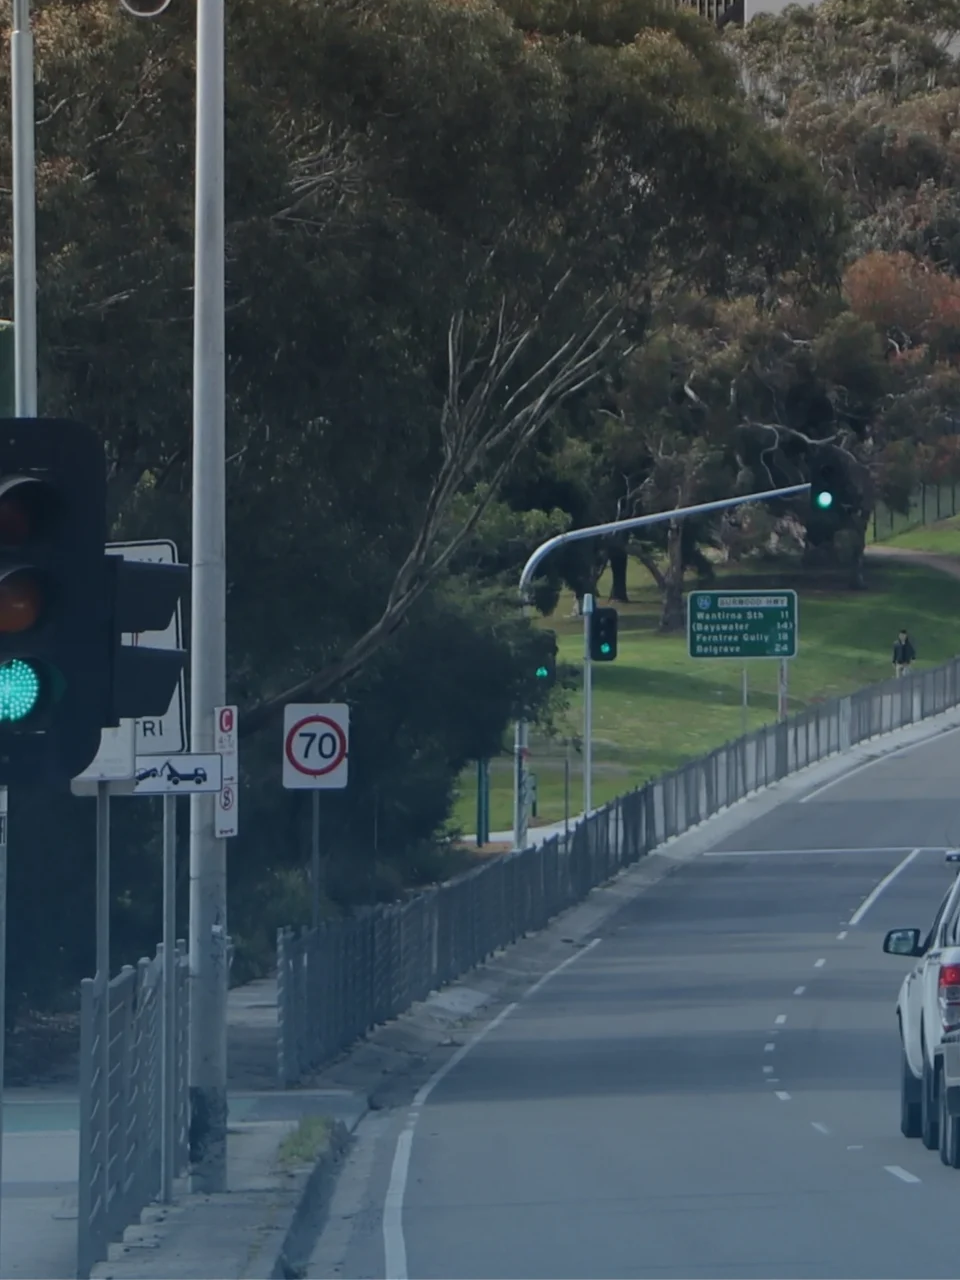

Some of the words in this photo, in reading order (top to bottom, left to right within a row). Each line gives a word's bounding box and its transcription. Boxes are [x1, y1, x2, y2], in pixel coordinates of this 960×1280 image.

[696, 611, 743, 620] Wantirna
[746, 610, 764, 619] Sth
[780, 610, 789, 619] 11
[742, 633, 770, 643] Gully
[298, 732, 337, 759] 70
